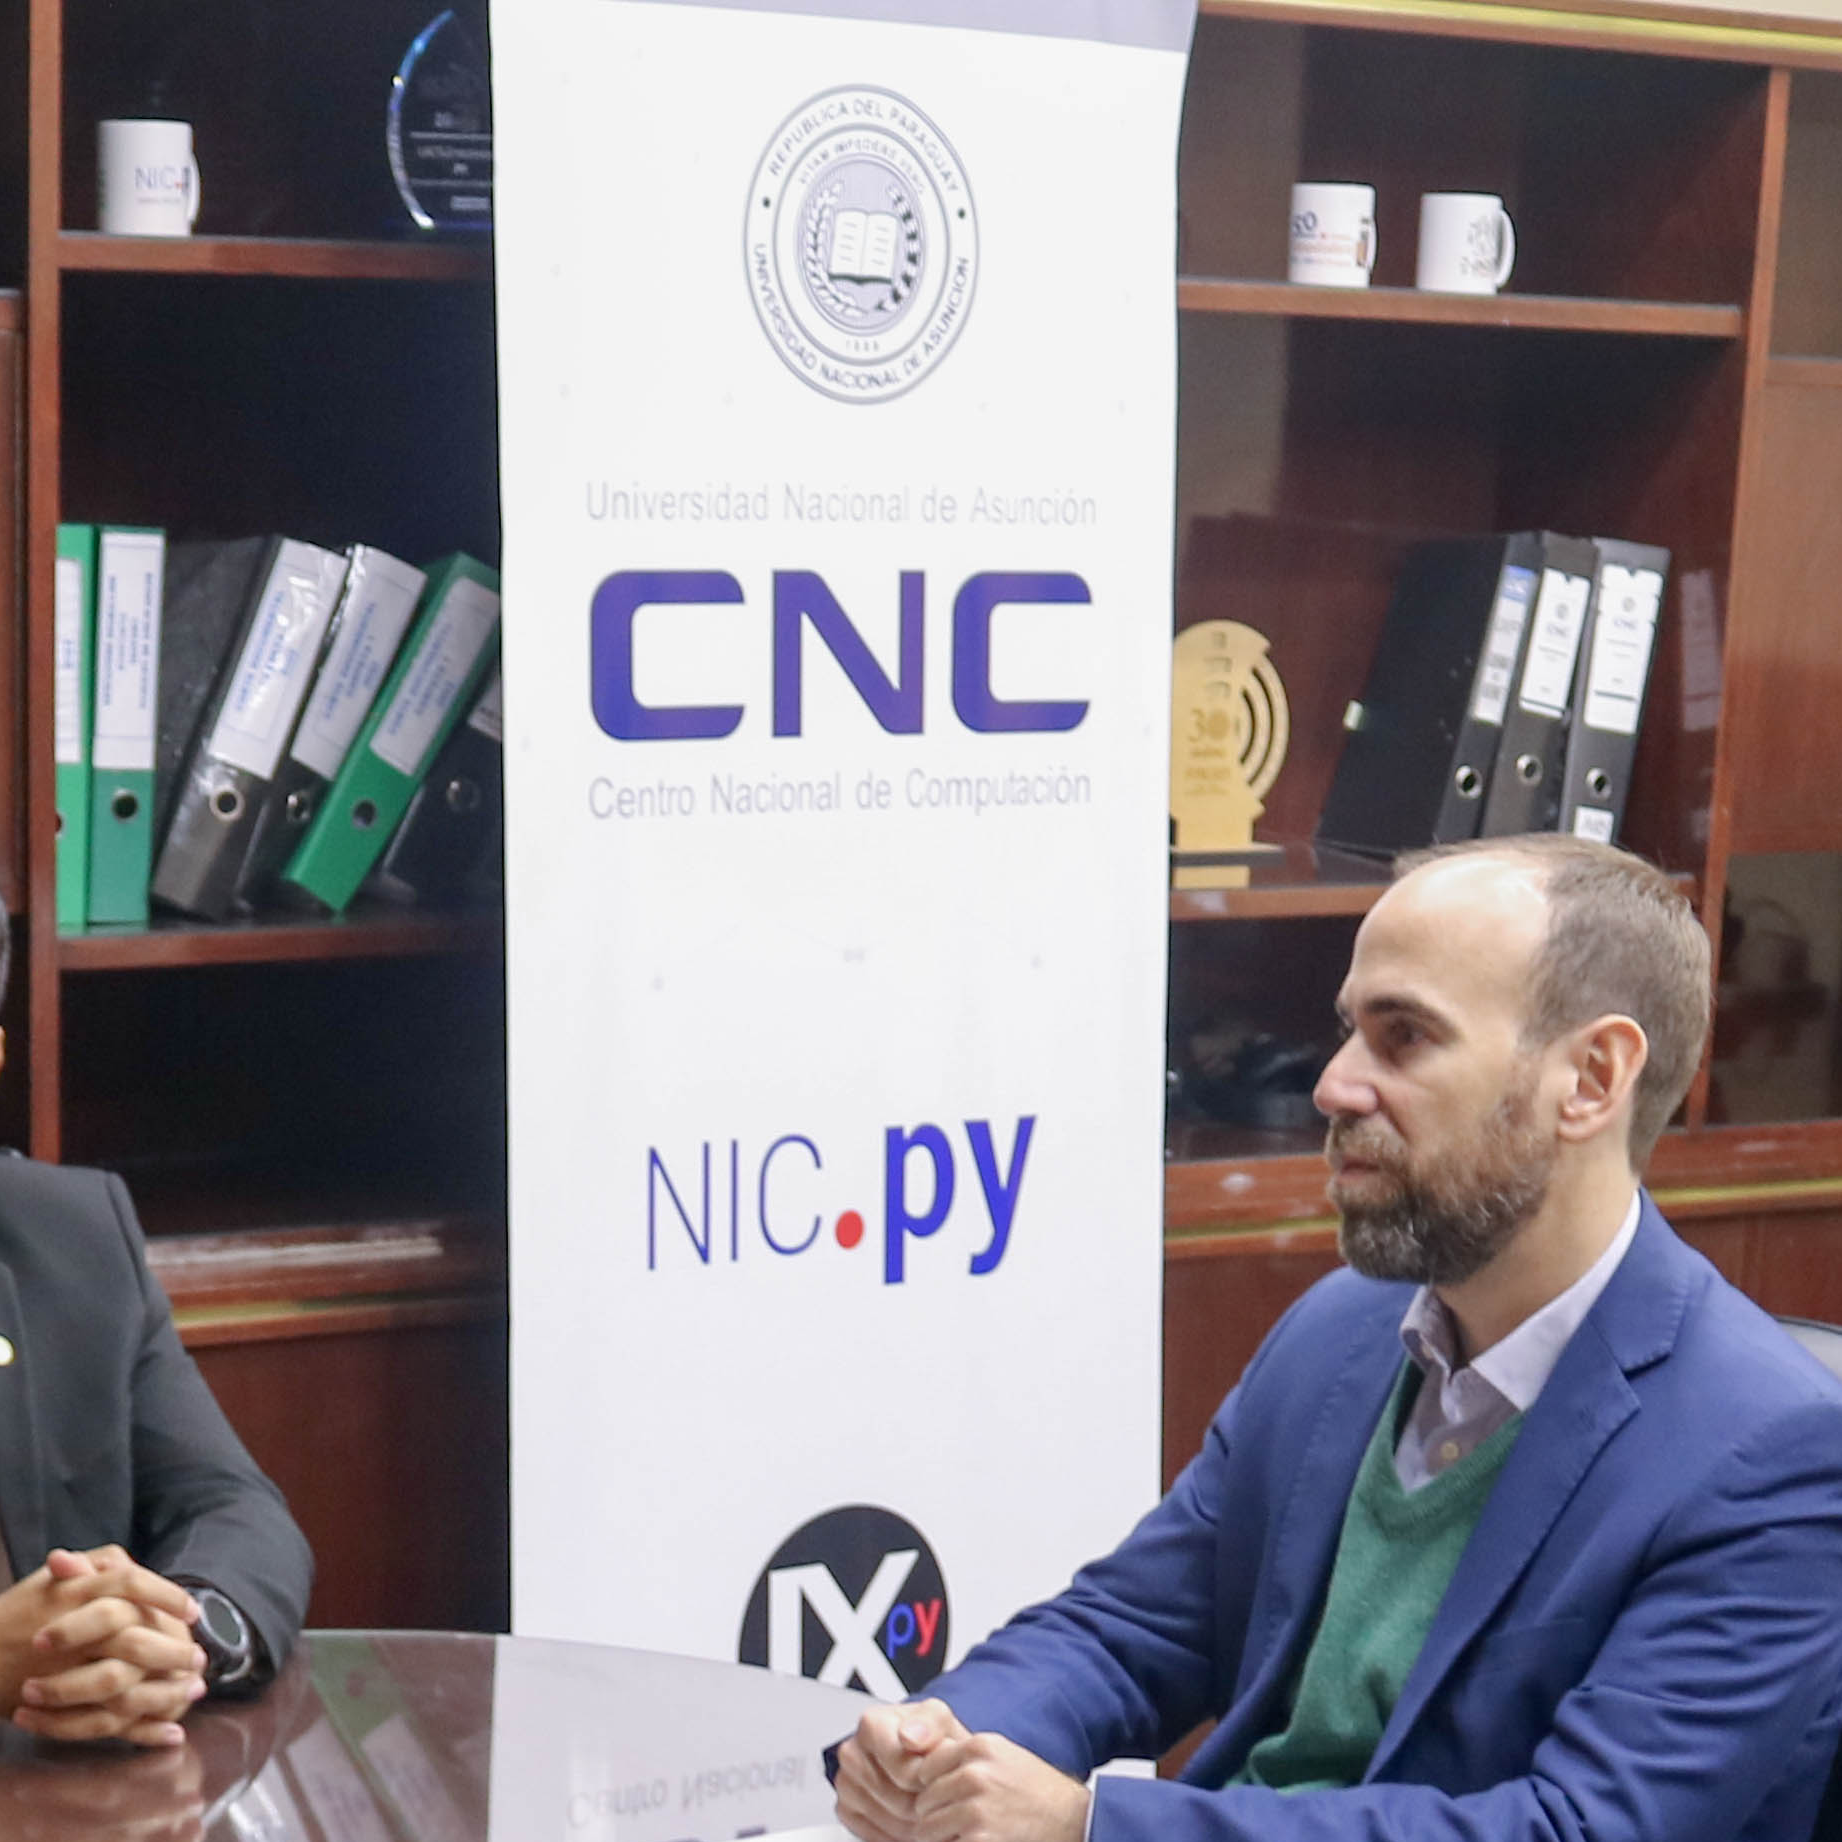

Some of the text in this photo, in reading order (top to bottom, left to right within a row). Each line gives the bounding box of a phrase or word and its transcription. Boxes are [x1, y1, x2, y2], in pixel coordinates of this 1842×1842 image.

[769, 101, 849, 177] REPUBLICA
[852, 98, 884, 119] DEL
[889, 106, 959, 193] PARAGUAY
[754, 243, 971, 389] UNIVERSIDAD NACIONAL DE ASUNCION
[586, 480, 1097, 526] Universidad Nacional de Asunción
[589, 569, 1092, 742] CNC
[588, 764, 1092, 819] Centro Nacional de Computación
[648, 1114, 1037, 1286] NIC.py
